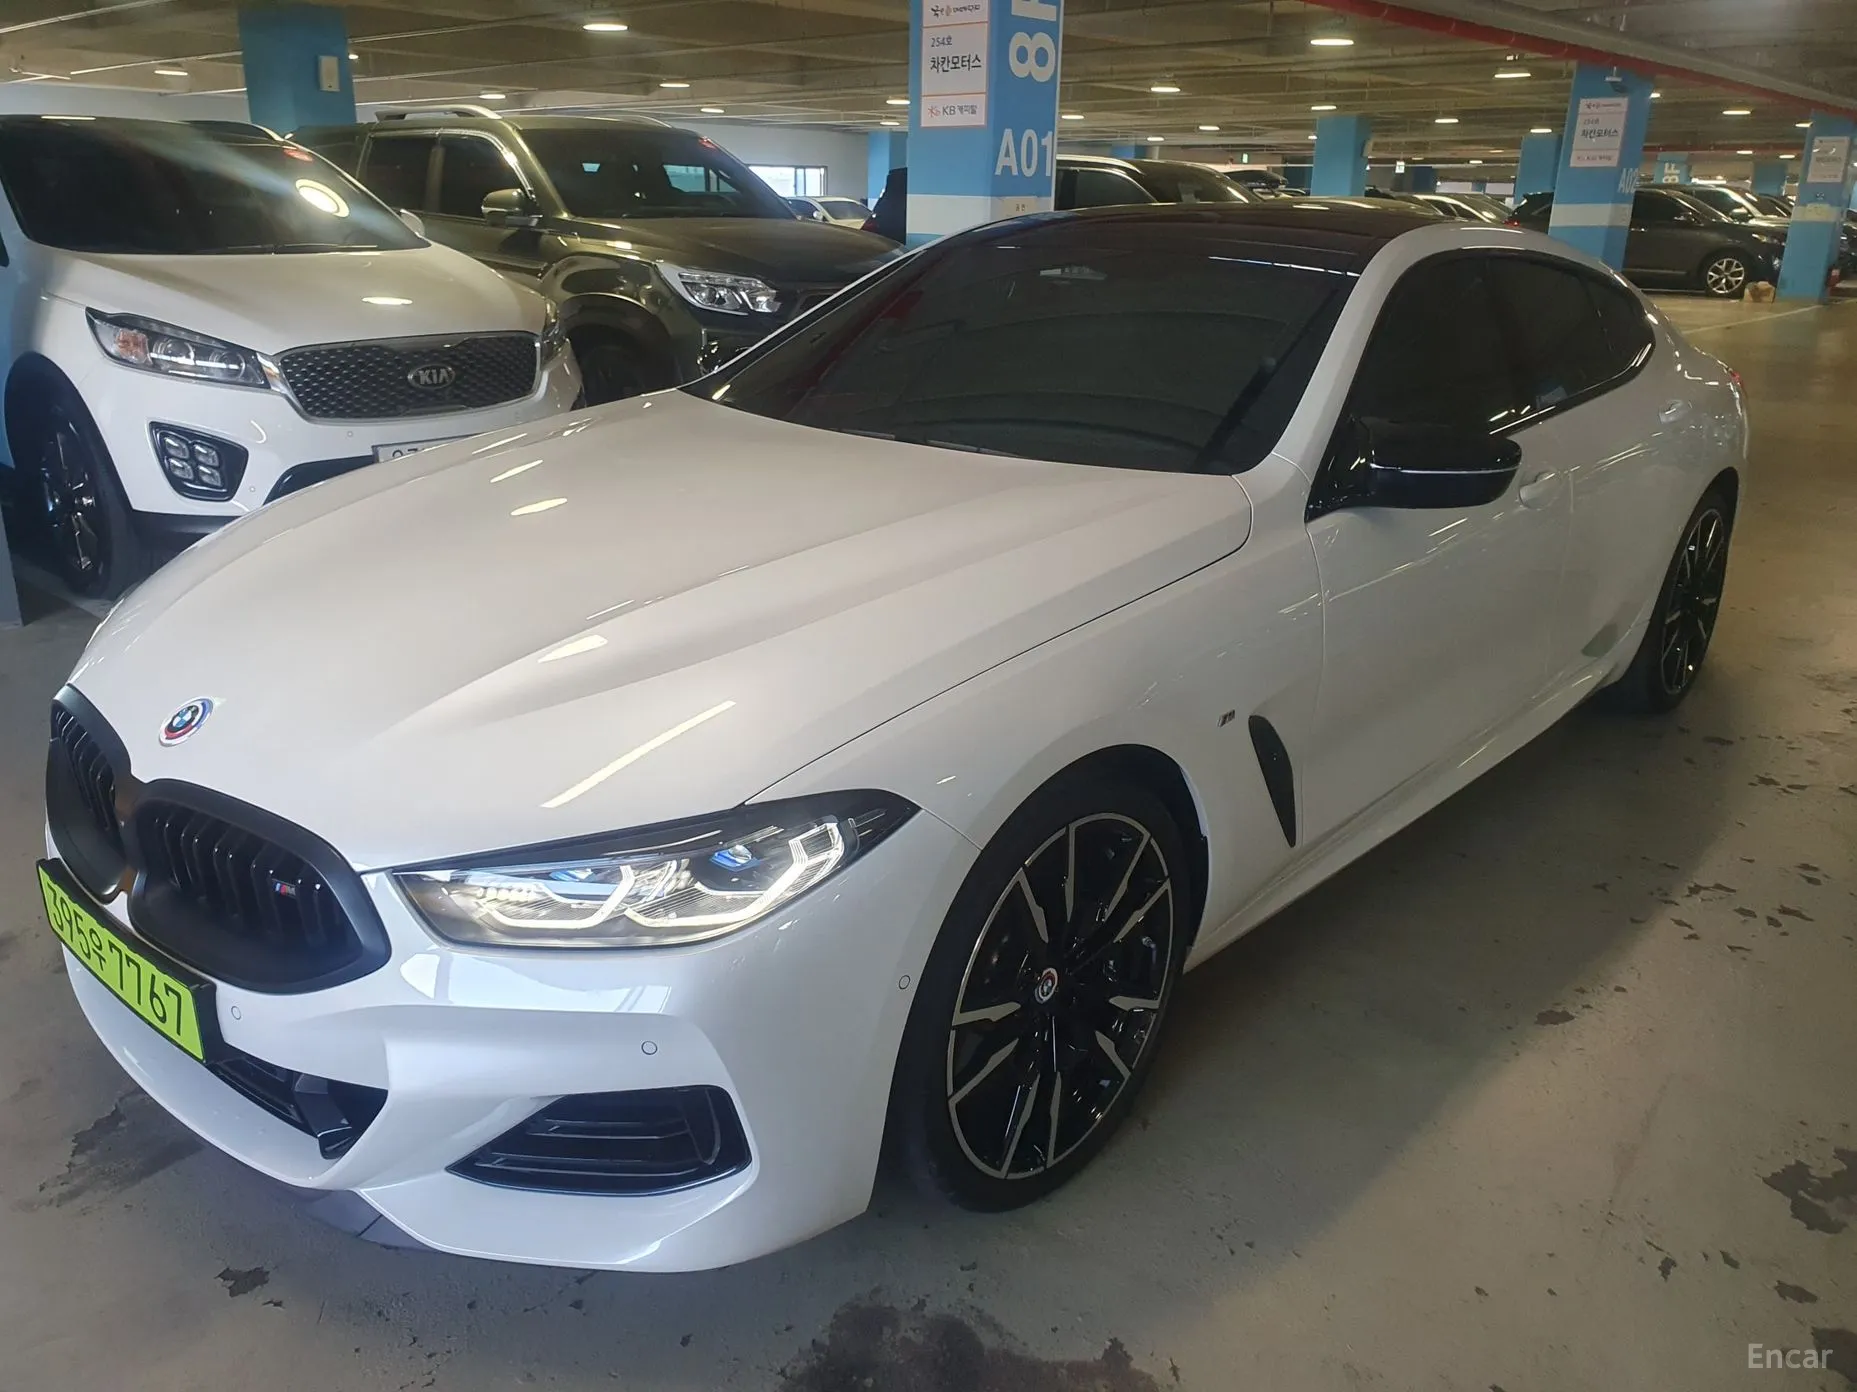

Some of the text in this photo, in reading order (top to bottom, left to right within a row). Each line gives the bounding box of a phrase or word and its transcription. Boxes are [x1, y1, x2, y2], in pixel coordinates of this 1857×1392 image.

[931, 35, 953, 48] 254호
[930, 53, 982, 73] 차칸모터스
[943, 105, 956, 116] KB
[994, 128, 1053, 177] A01
[418, 368, 449, 385] KIA
